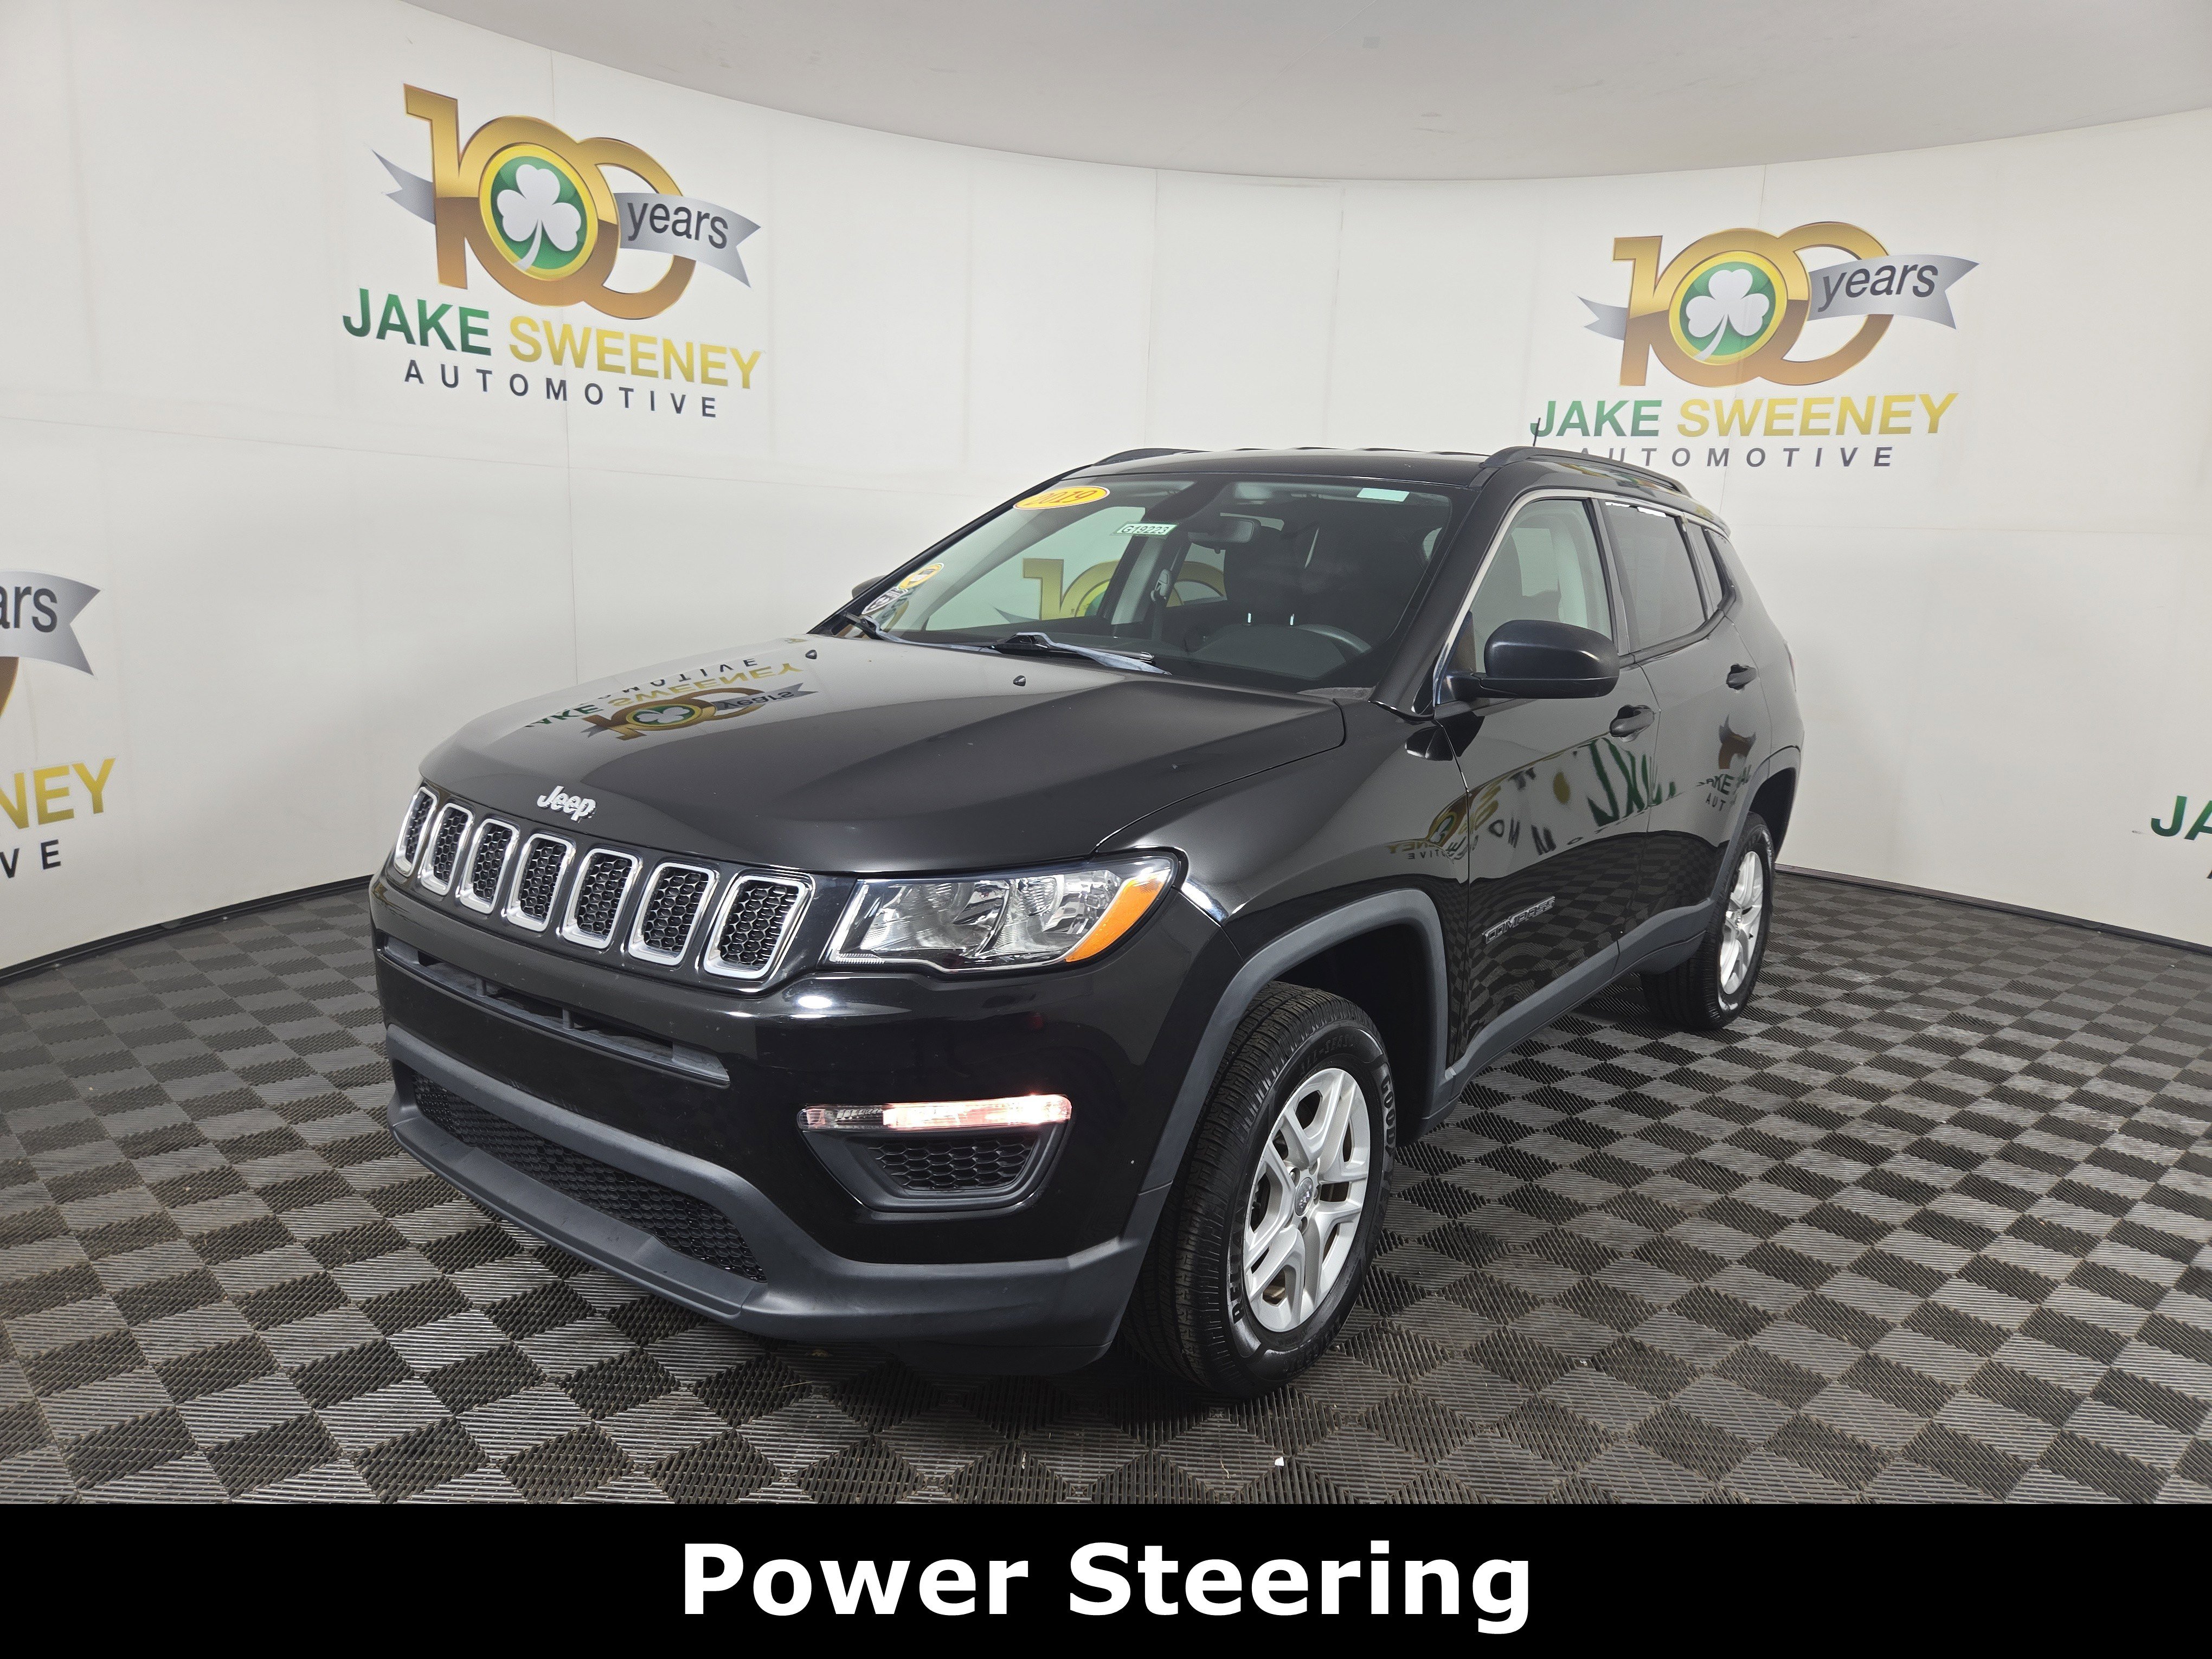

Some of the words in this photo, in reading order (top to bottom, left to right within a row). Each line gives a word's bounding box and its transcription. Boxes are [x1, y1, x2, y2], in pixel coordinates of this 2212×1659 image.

[403, 83, 698, 320] 100
[627, 200, 729, 250] years
[1612, 221, 1895, 388] 100
[1818, 261, 1939, 312] years
[343, 288, 492, 356] JAKE
[509, 315, 761, 389] SWEENEY
[404, 359, 717, 418] AUTOMOTIVE
[1530, 400, 1662, 438] JAKE
[1677, 393, 1959, 438] SWEENEY
[1023, 490, 1098, 506] 2019
[1121, 525, 1169, 534] G19223
[537, 786, 596, 821] Jeep
[1485, 896, 1555, 944] COMPASS
